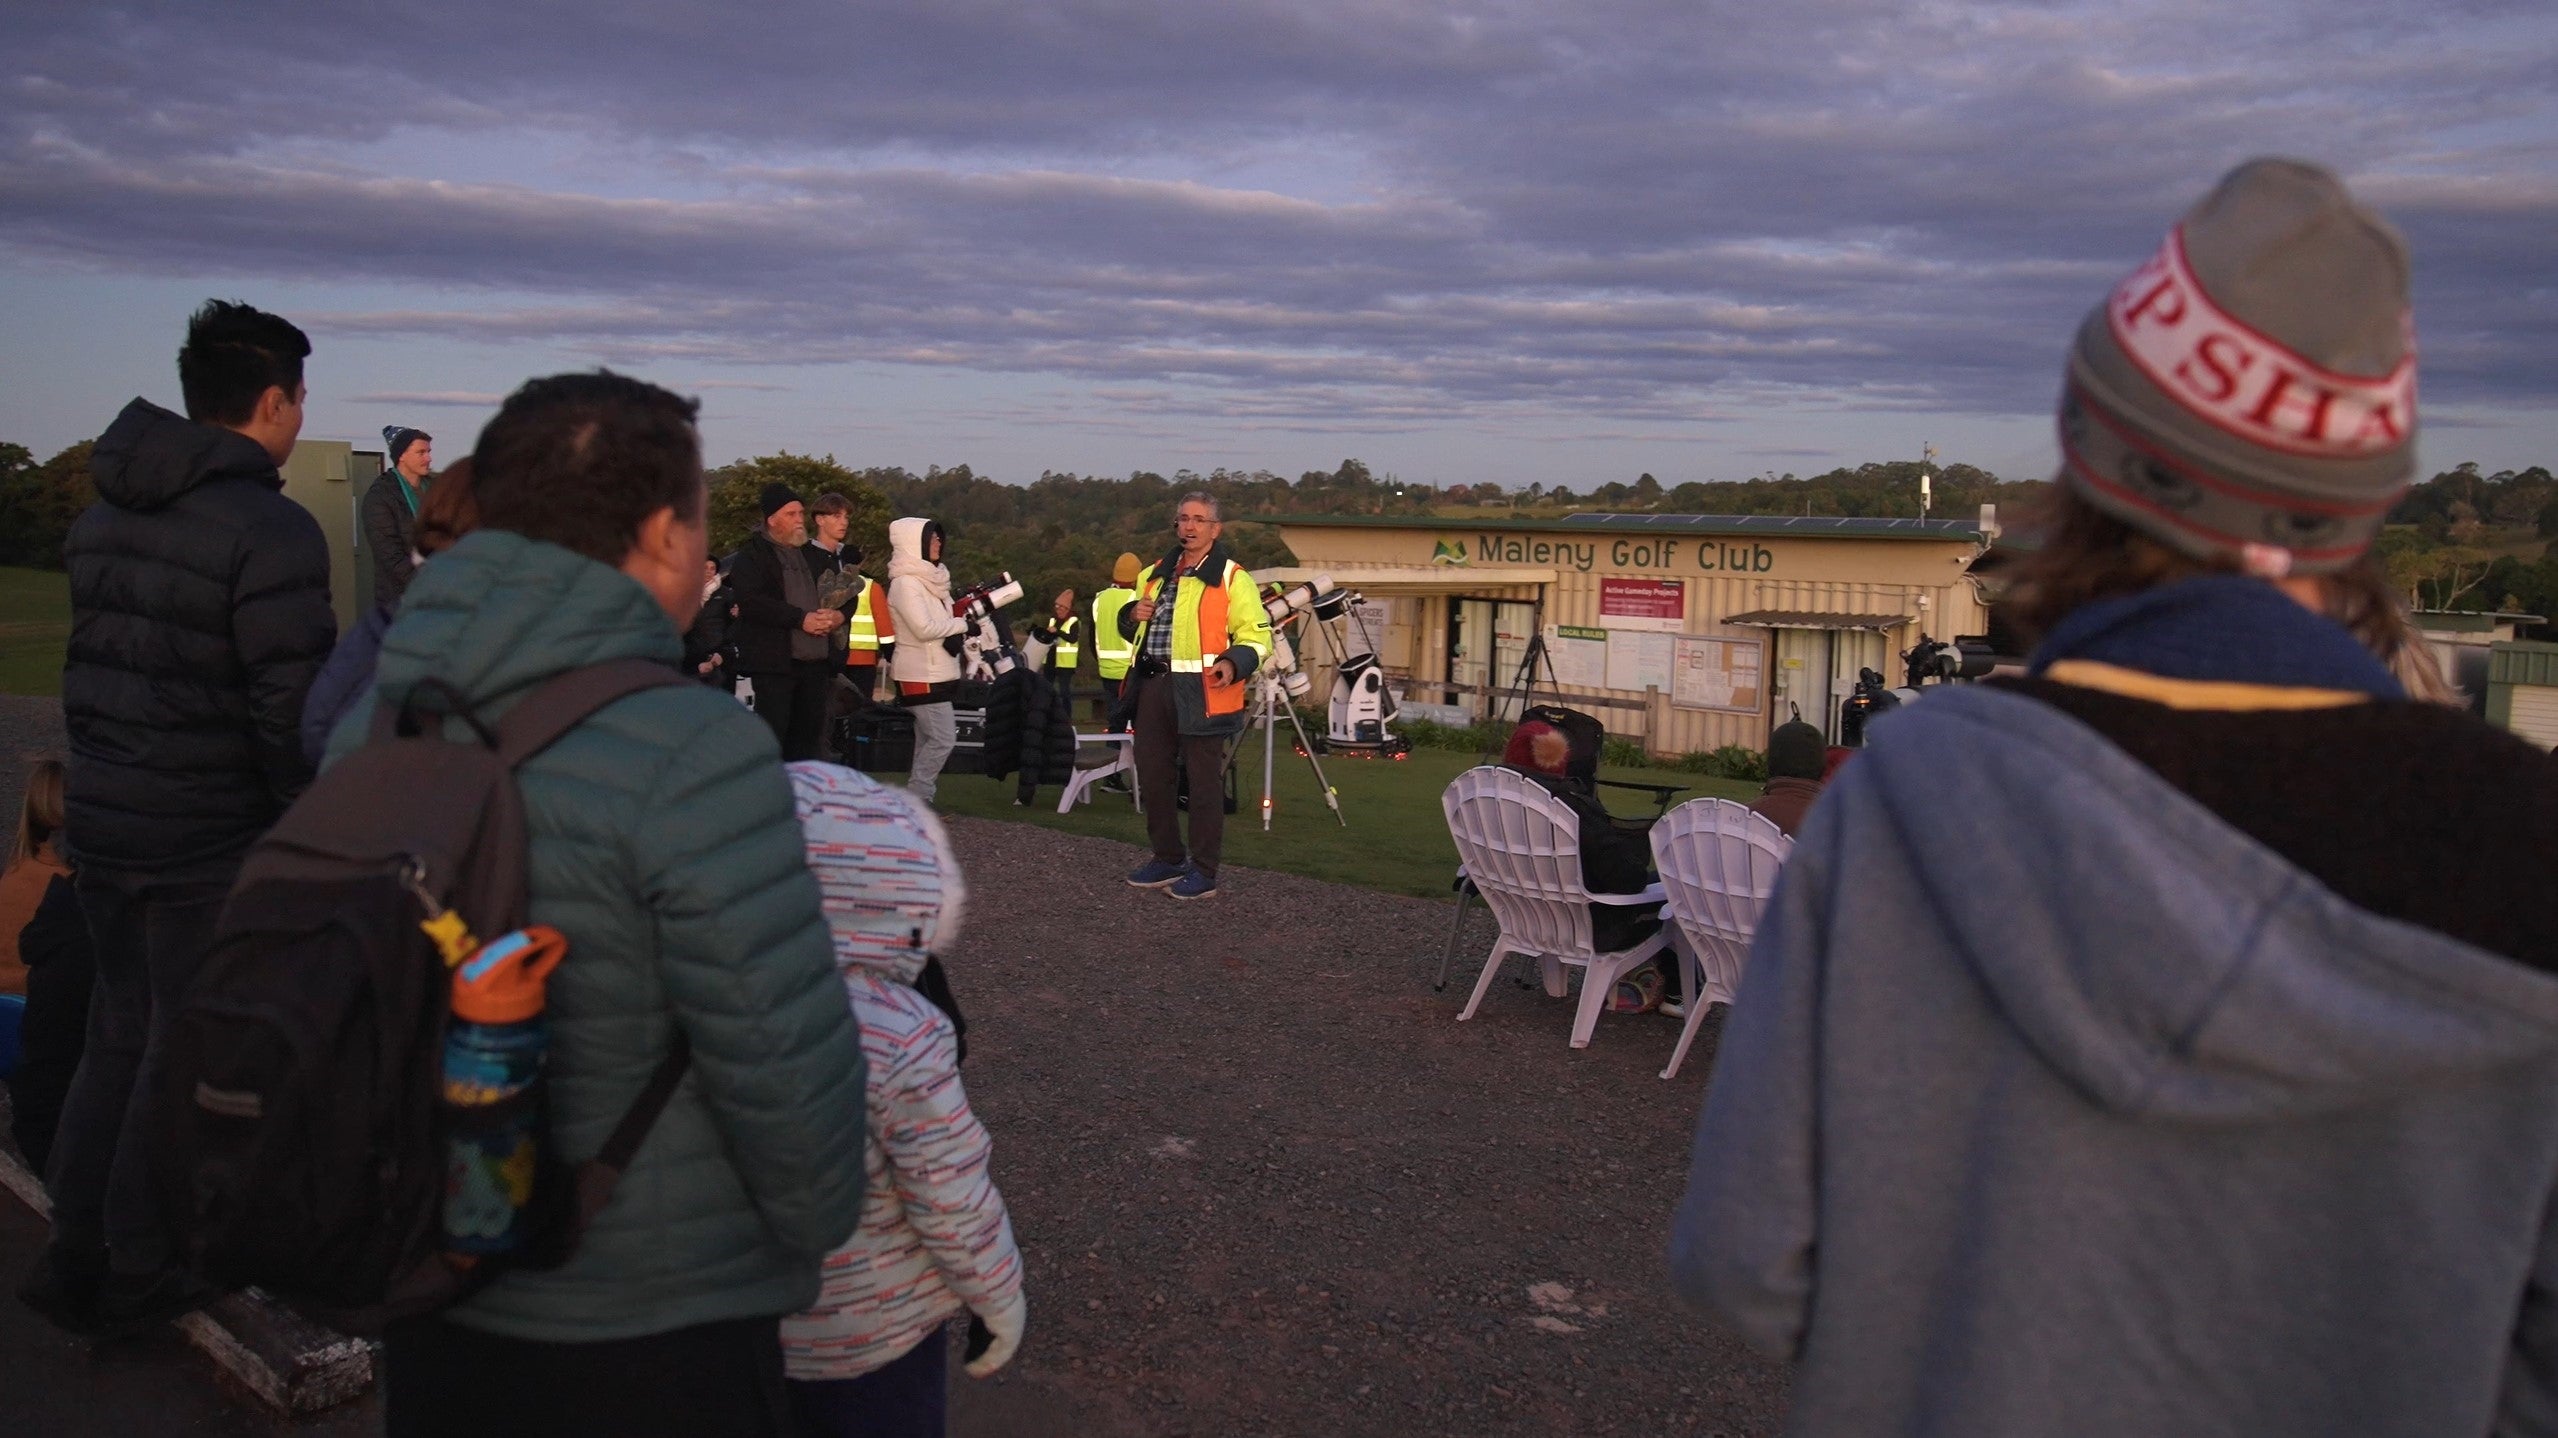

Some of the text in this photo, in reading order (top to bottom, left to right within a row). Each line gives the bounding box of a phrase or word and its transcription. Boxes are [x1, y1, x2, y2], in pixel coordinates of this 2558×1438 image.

[1478, 535, 1773, 572] Maleny Golf Club
[1653, 588, 1679, 597] Projects
[1559, 628, 1605, 639] LOCAL RULES
